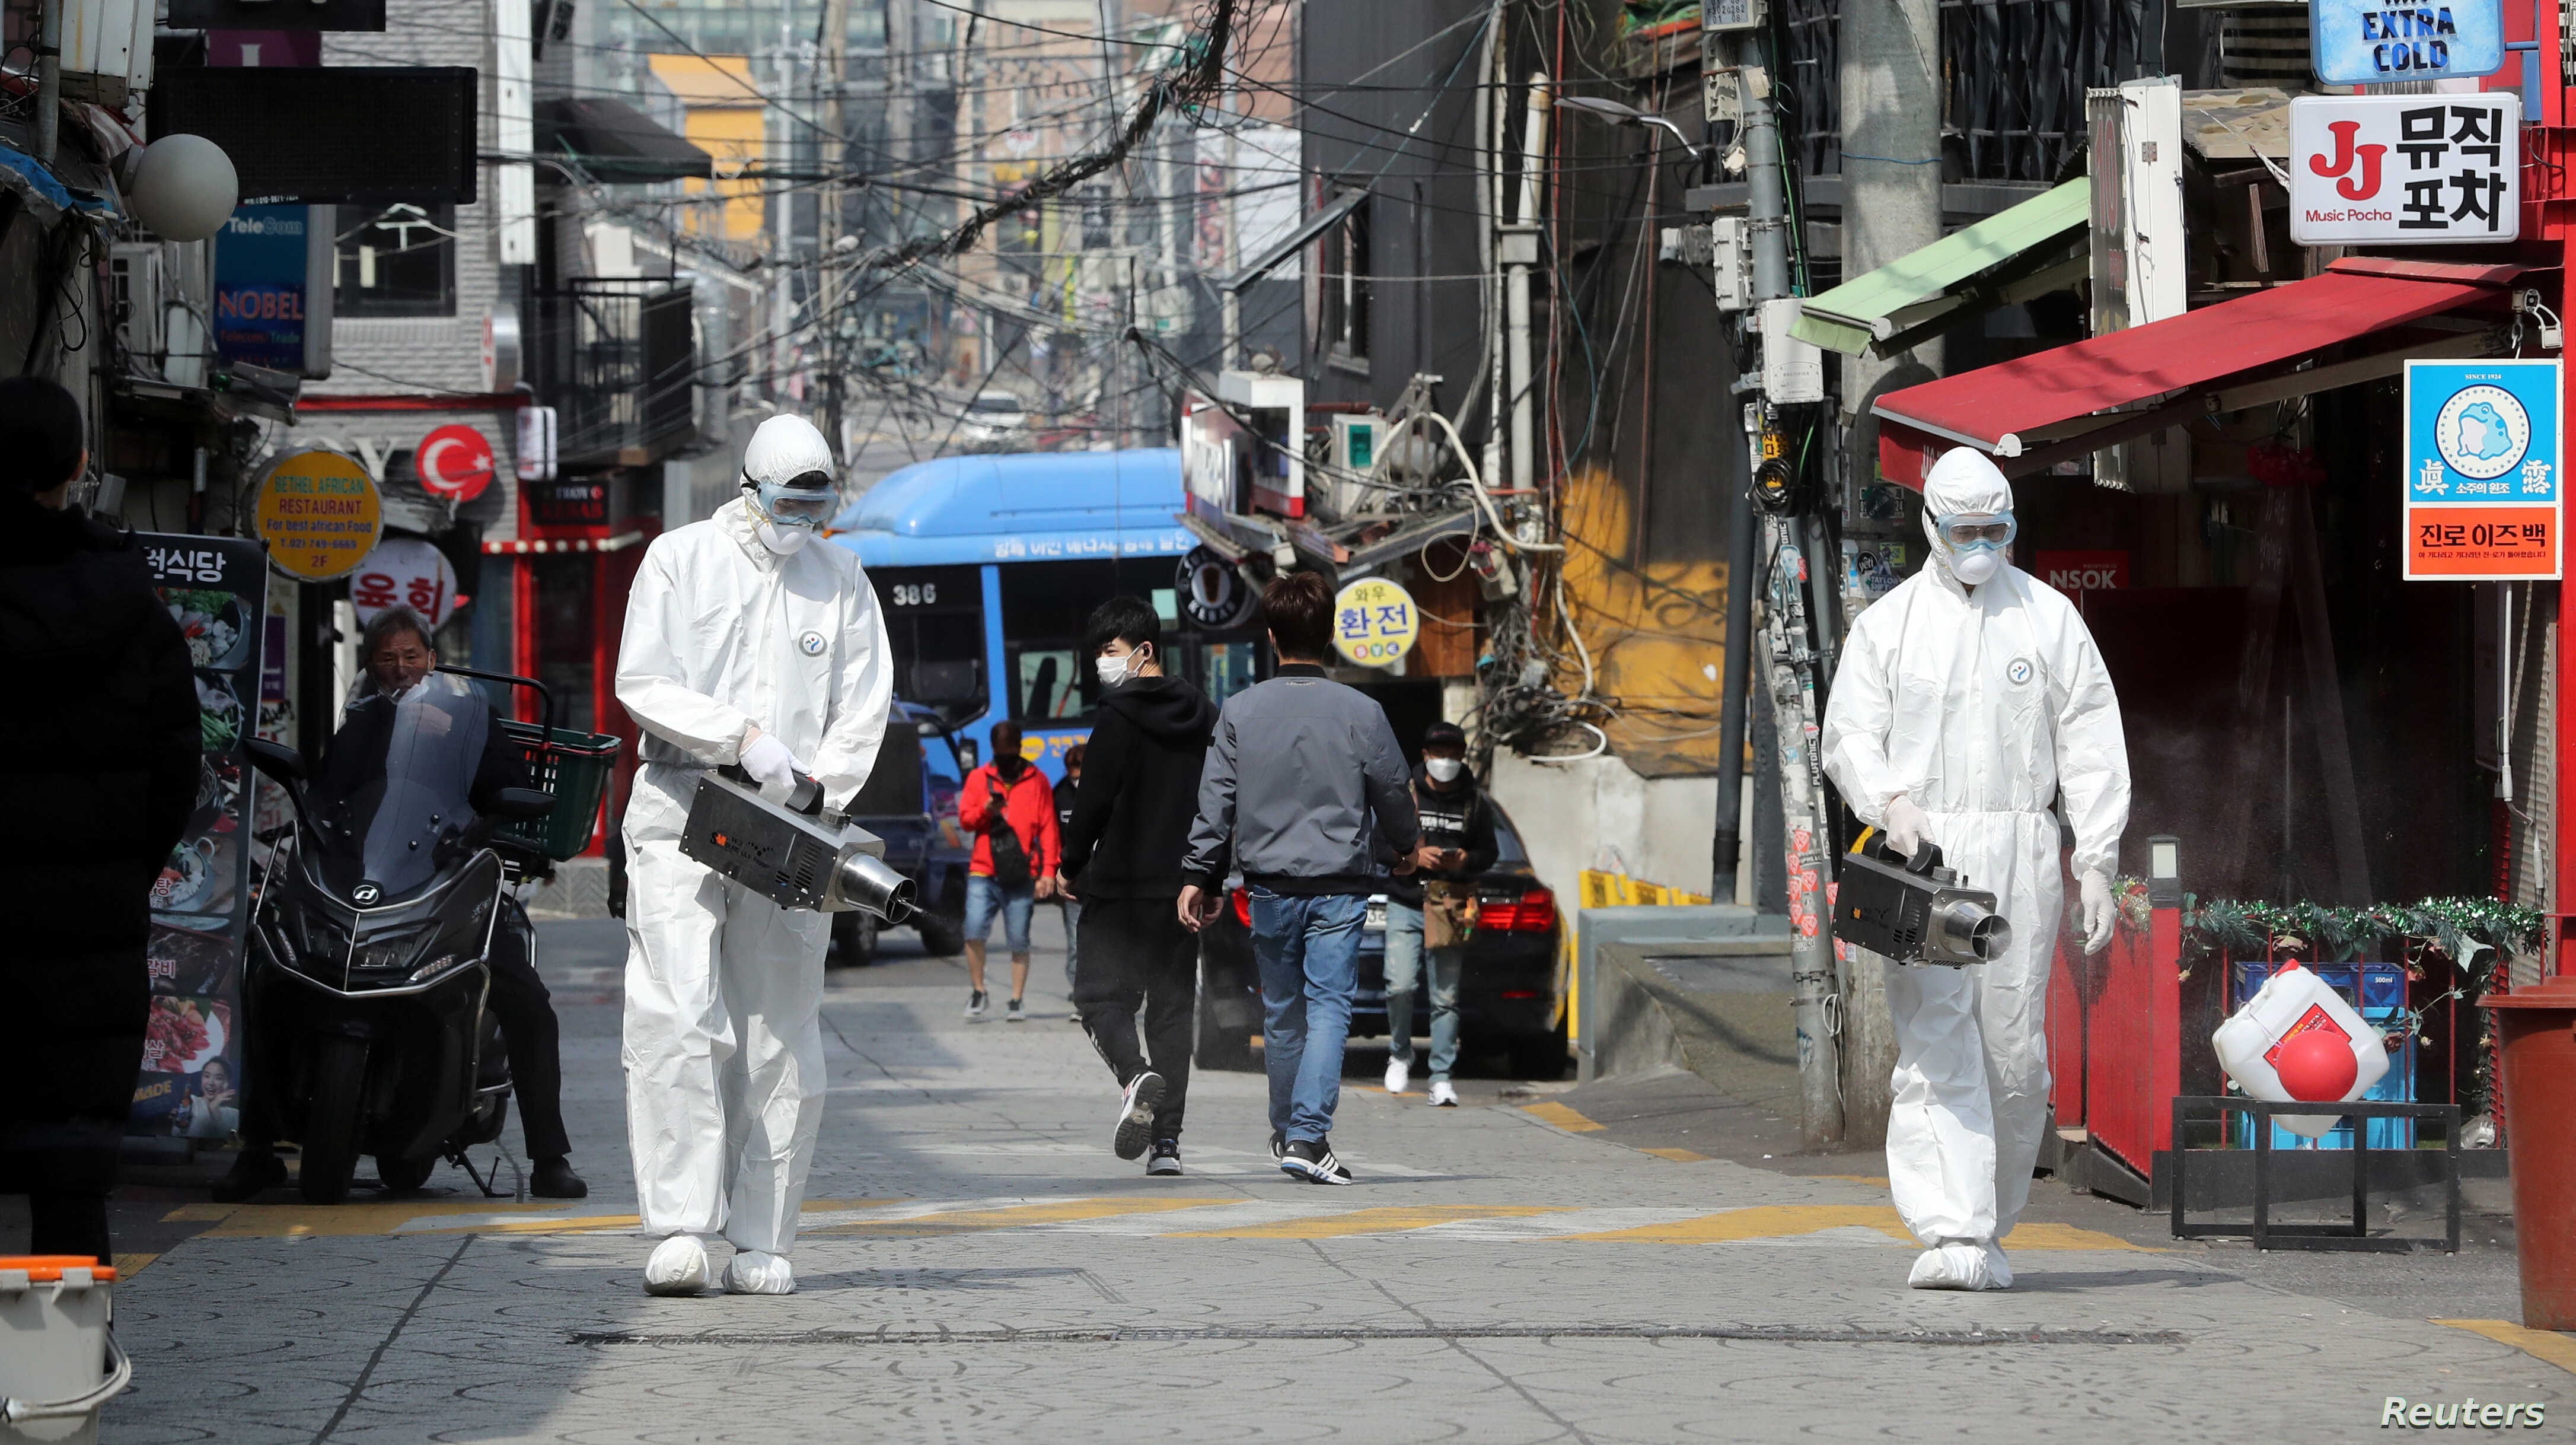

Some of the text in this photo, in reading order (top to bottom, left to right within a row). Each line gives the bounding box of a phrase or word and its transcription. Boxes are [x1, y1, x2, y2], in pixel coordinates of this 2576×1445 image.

[1732, 14, 1740, 23] 08
[2362, 7, 2456, 40] EXTRA
[2373, 40, 2449, 72] COLD
[2396, 105, 2503, 170] 뮤직
[2309, 120, 2388, 201] JJ
[2095, 113, 2118, 237] 10
[2398, 169, 2507, 232] 포차
[2306, 208, 2392, 222] Music Pocha
[218, 290, 304, 320] NOBEL
[275, 476, 365, 495] BETHEL AFRICAN
[2414, 459, 2552, 496] 眞 露
[2456, 483, 2510, 494] 소주의 원조
[279, 498, 362, 515] RESTAURANT
[267, 518, 372, 533] For best african Food
[2420, 524, 2546, 548] 진로 이즈 백
[311, 555, 327, 568] 2F
[2049, 569, 2117, 589] NSOK
[892, 583, 937, 606] 386
[1355, 585, 1386, 602] 와우
[1340, 603, 1408, 640] 환전
